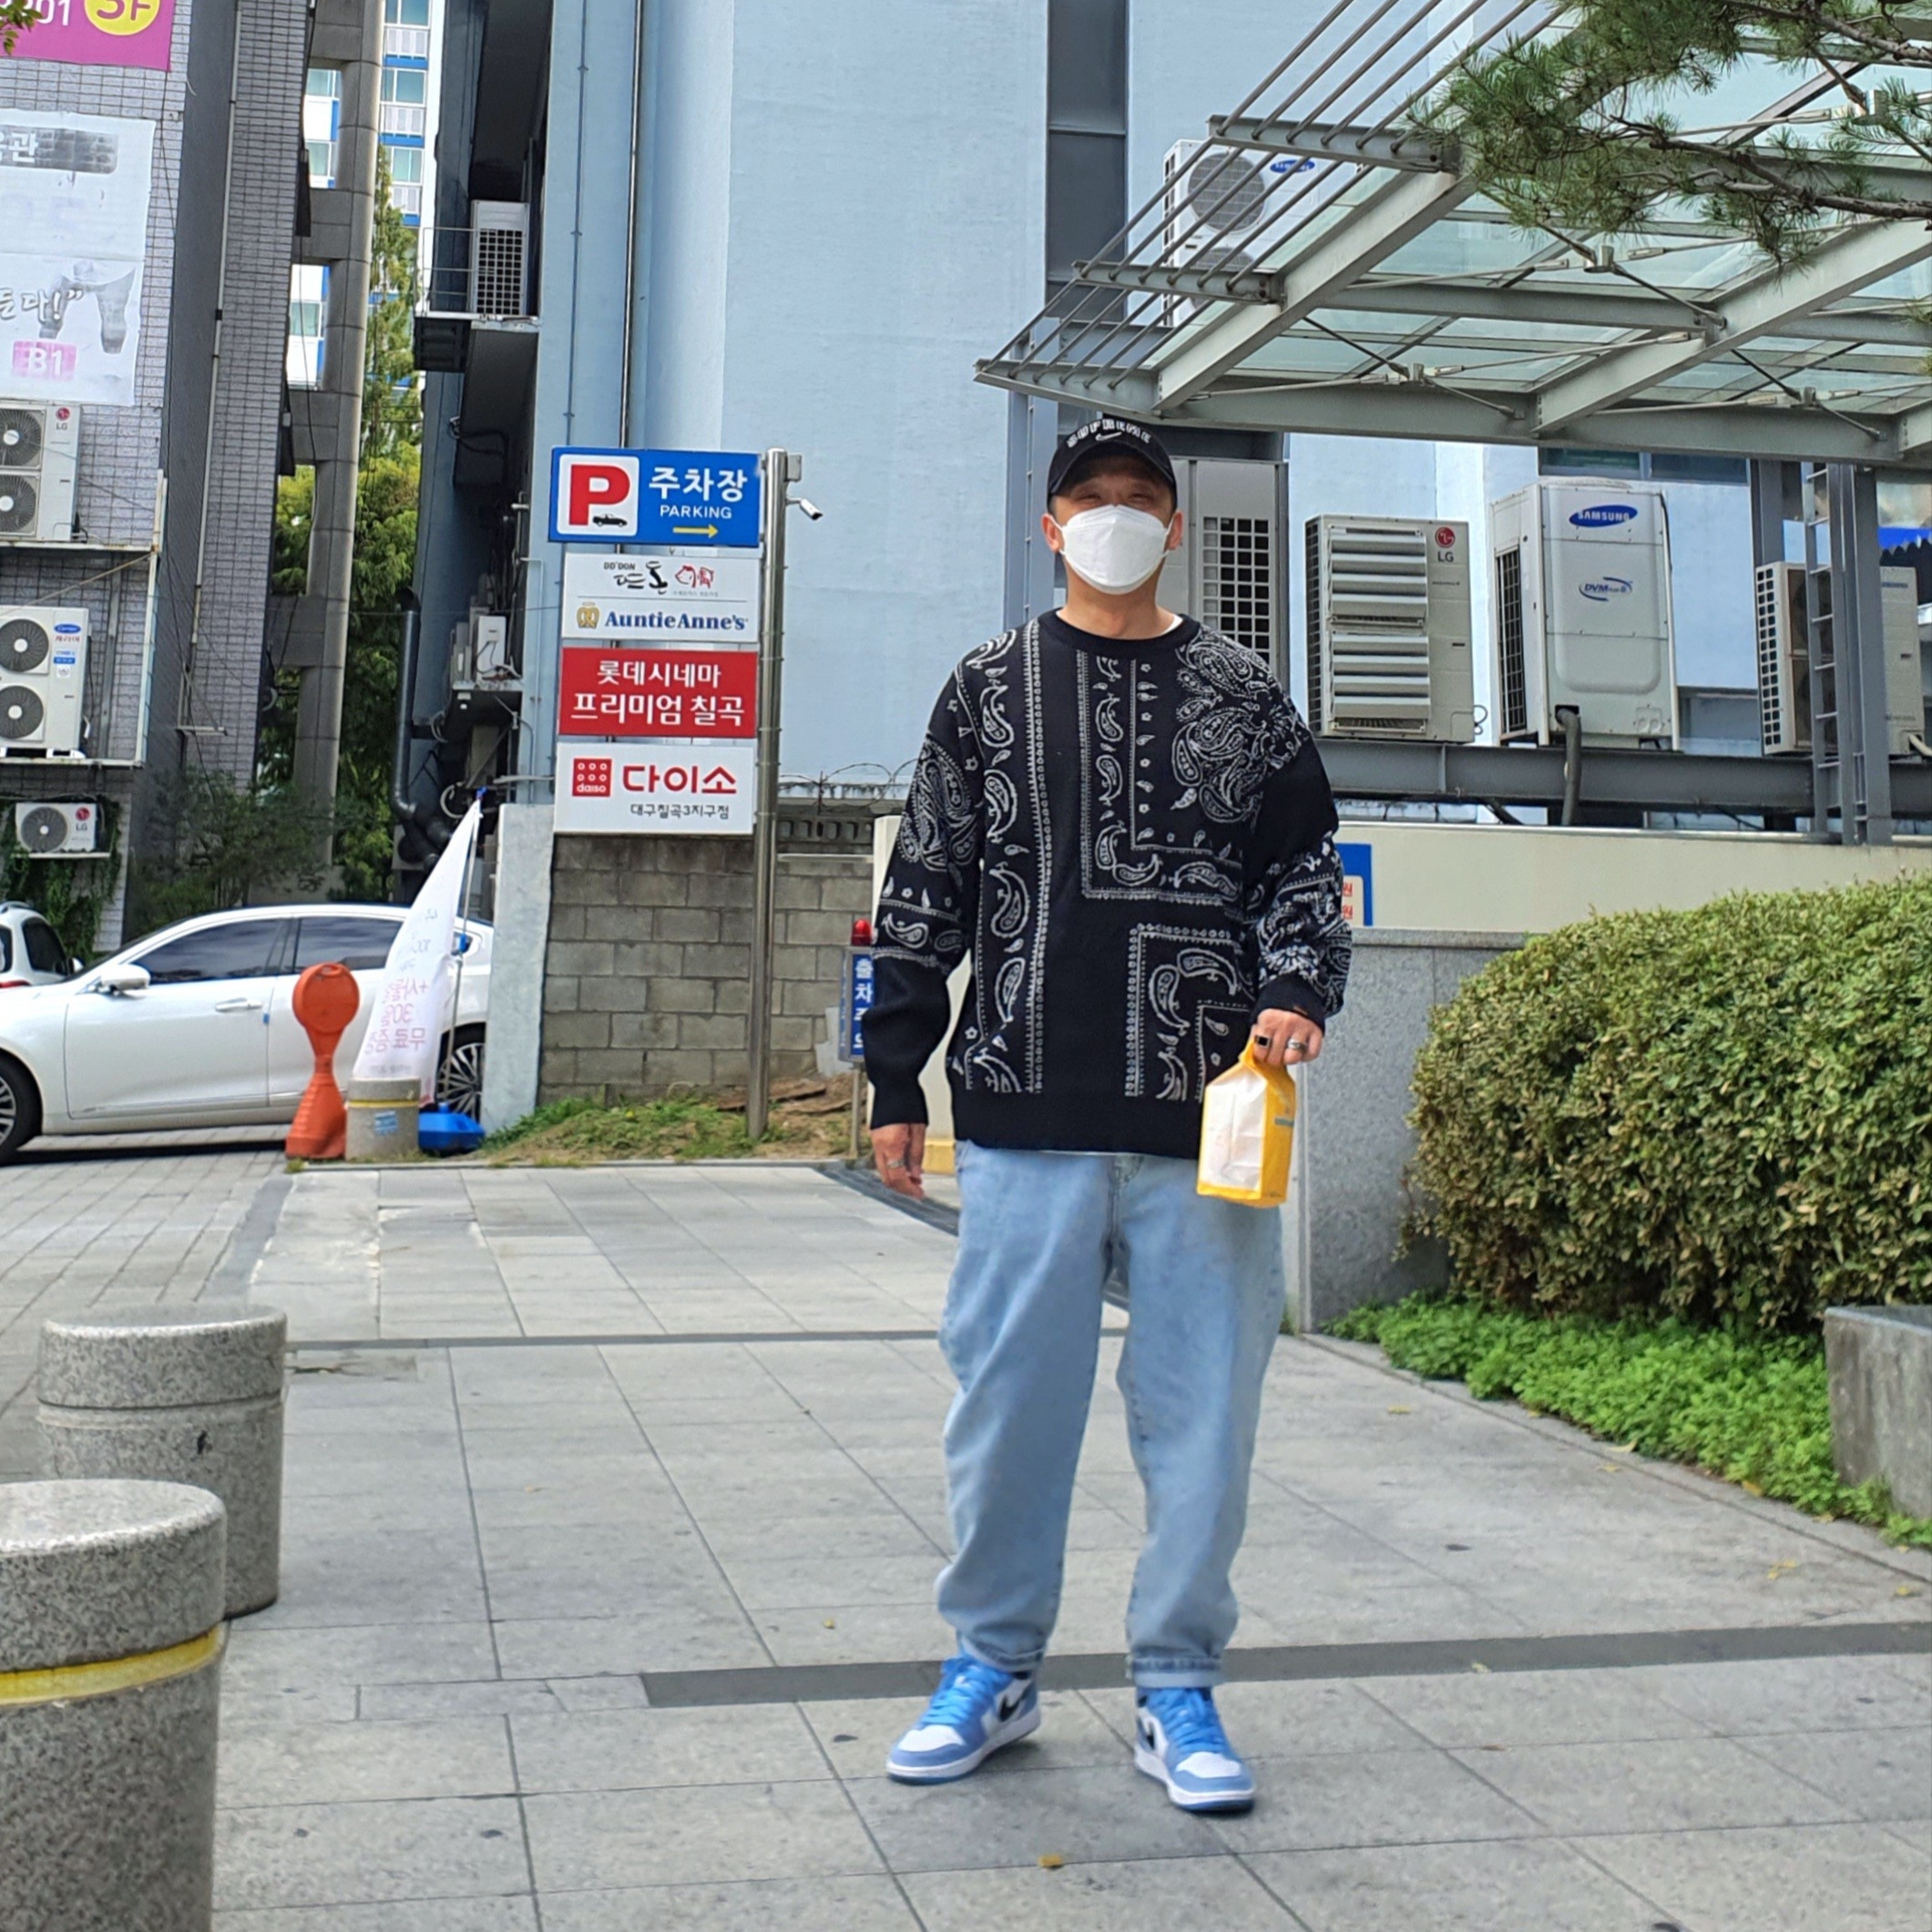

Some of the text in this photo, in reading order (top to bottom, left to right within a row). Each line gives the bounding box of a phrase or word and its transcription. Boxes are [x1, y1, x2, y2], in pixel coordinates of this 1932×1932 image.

[569, 464, 630, 526] P
[649, 466, 748, 502] 주차장
[659, 505, 732, 518] PARKING
[1578, 510, 1630, 522] SAMSUNG
[1437, 551, 1455, 562] LG
[605, 611, 745, 630] Auntie Anne's
[598, 659, 721, 689] 롯데시네마
[571, 693, 744, 727] 프리미엄 칠곡
[577, 783, 607, 793] daiso
[623, 765, 737, 794] 다이소
